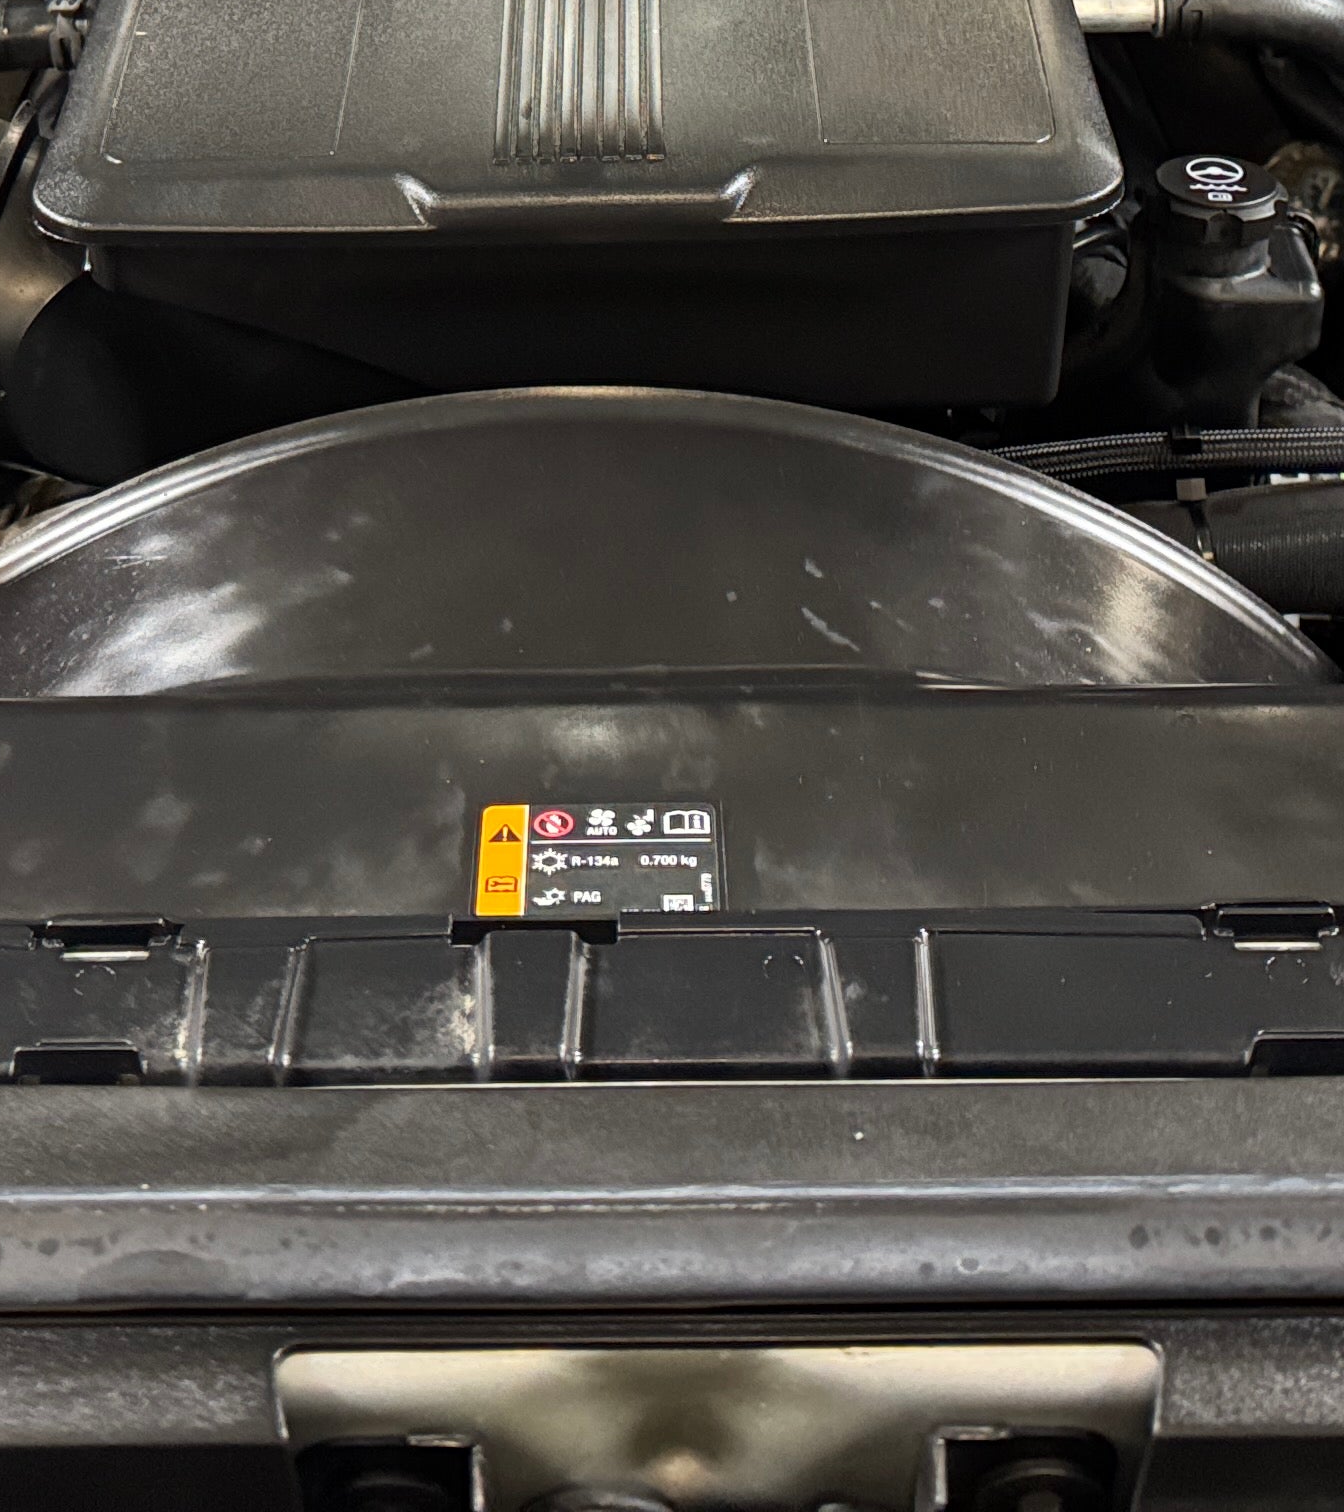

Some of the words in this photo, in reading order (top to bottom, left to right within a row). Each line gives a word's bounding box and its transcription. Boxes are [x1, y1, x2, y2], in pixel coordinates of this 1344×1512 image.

[586, 826, 617, 836] AUTO
[571, 855, 619, 866] R-134a
[640, 855, 677, 866] 0.700
[680, 855, 697, 868] kg
[573, 891, 601, 903] PAG
